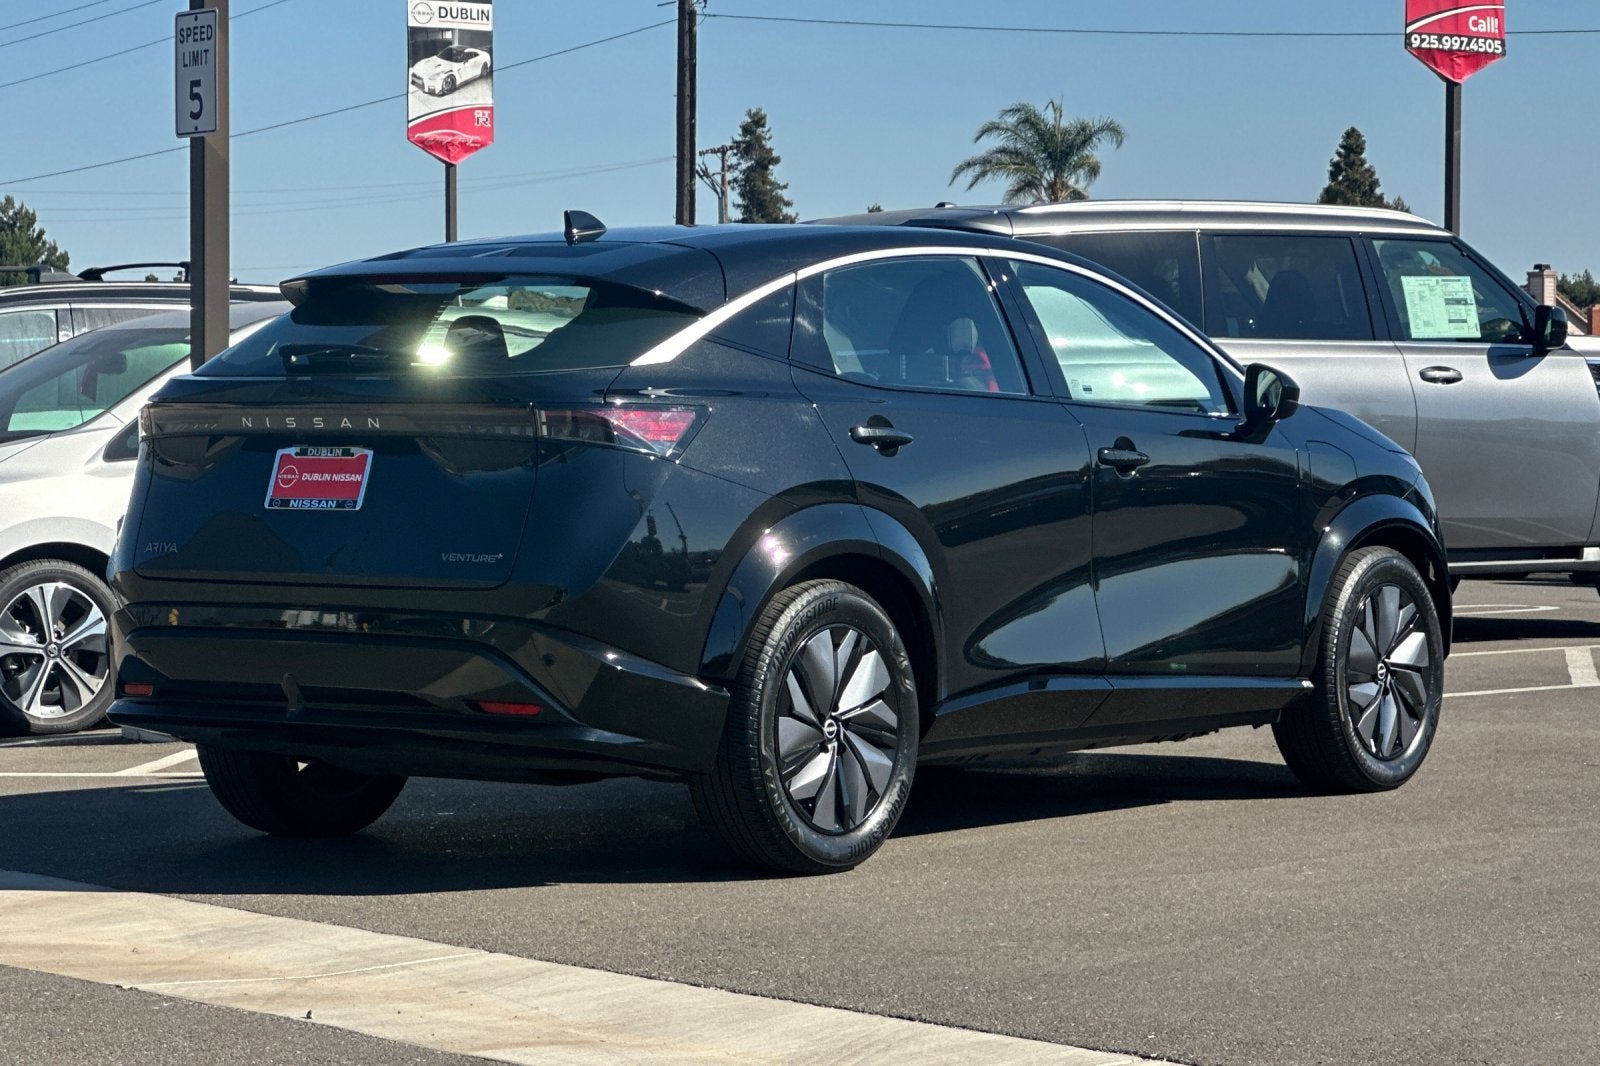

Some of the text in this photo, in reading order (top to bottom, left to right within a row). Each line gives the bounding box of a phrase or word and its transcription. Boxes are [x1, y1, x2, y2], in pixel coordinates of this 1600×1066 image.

[438, 6, 490, 22] DUBLIN
[1468, 15, 1499, 34] Call!
[179, 24, 213, 44] SPEED
[1411, 34, 1503, 54] 925.997.4505
[182, 49, 209, 68] LIMIT
[189, 79, 203, 120] 5
[241, 417, 380, 429] NISSAN
[307, 447, 343, 457] DUBLIN
[301, 473, 362, 482] DUBLIN NISSAN
[289, 499, 336, 508] NISSAN
[143, 542, 178, 553] ARIYA
